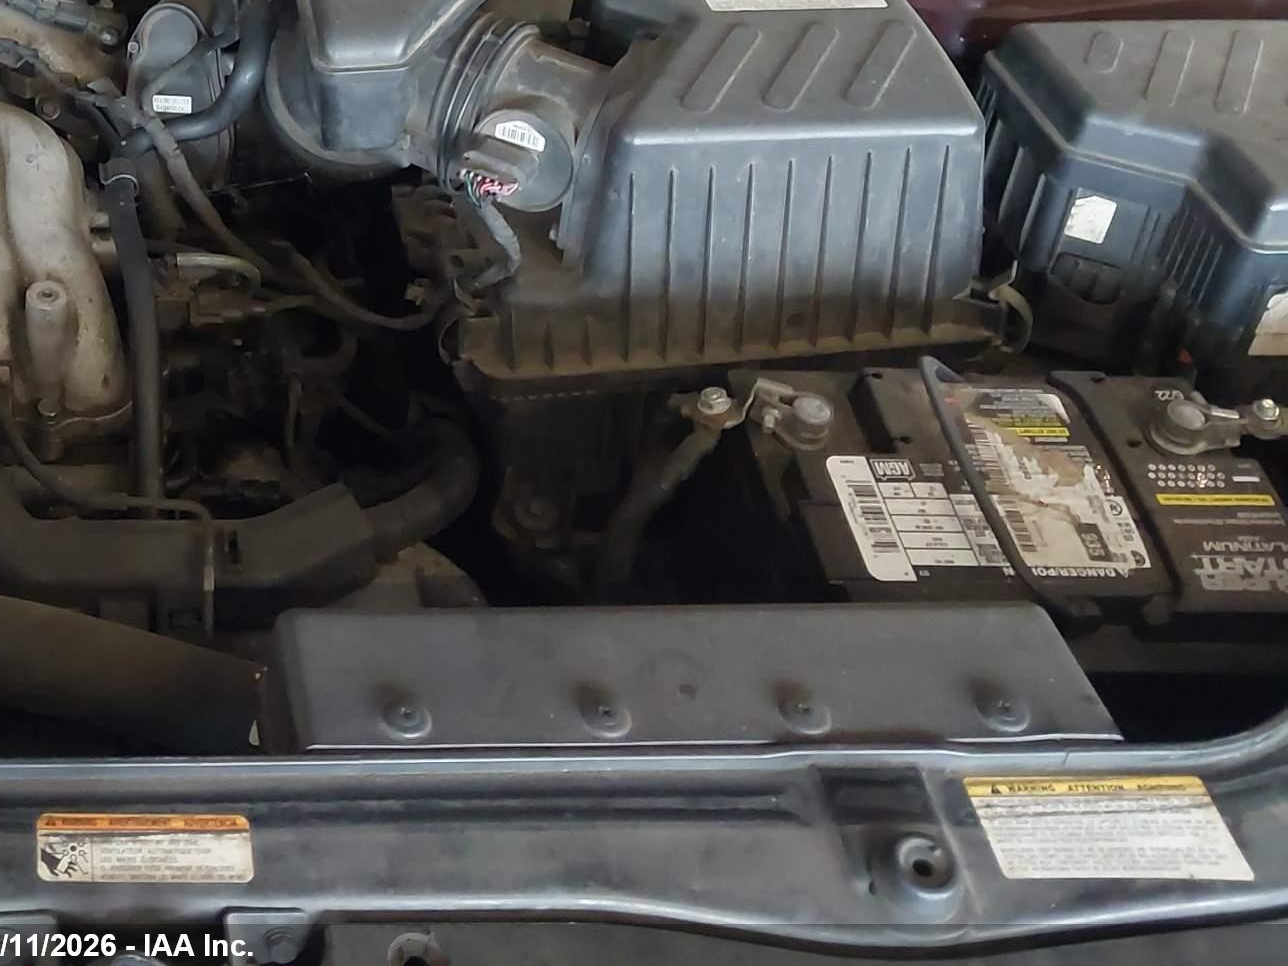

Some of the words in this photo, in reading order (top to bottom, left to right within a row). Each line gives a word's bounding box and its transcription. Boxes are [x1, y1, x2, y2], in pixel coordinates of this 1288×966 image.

[874, 461, 910, 475] AGM
[1008, 784, 1056, 792] WARNING
[1067, 784, 1125, 792] ATTENTION
